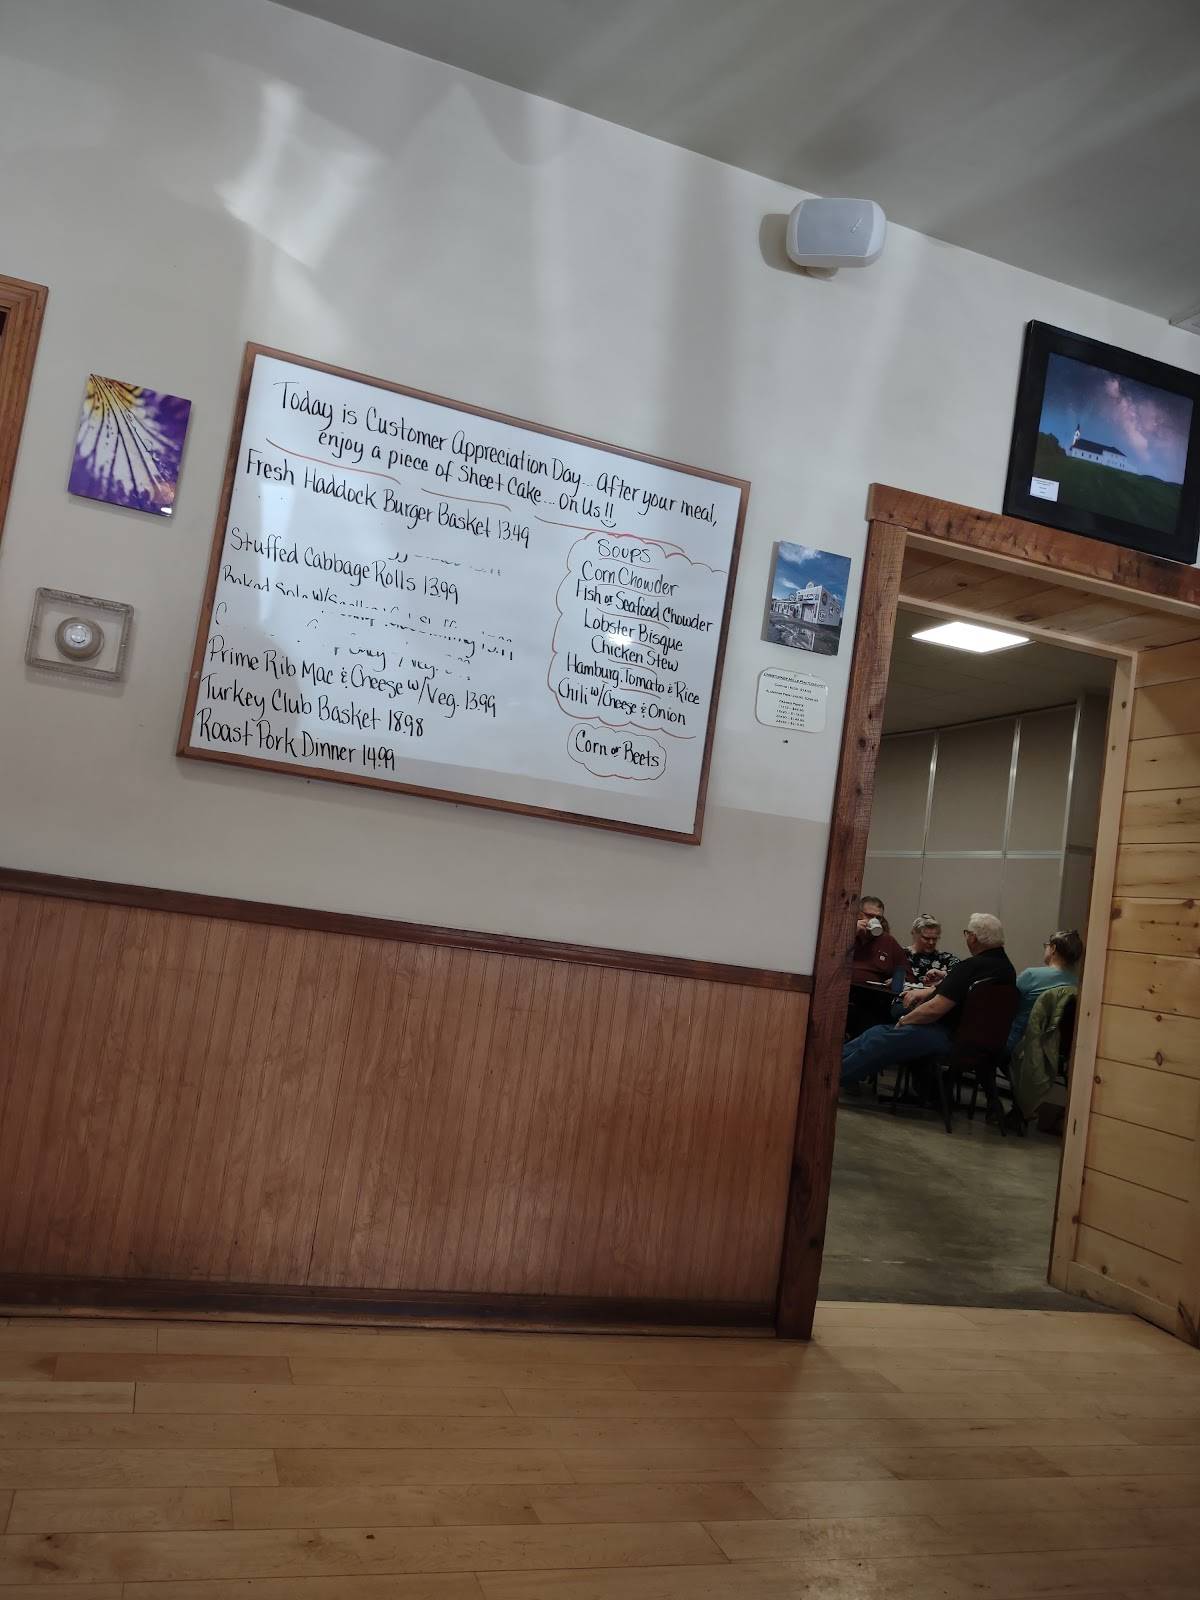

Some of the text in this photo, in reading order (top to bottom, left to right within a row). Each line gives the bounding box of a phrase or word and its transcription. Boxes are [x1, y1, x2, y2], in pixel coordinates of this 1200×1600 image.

[273, 381, 333, 432] Today
[342, 404, 358, 425] is
[366, 406, 448, 451] Customer
[451, 430, 548, 478] Appreciation
[596, 472, 642, 502] After
[638, 490, 676, 516] your
[680, 501, 719, 527] meal,
[318, 430, 365, 463] enjoy
[371, 445, 381, 460] a
[388, 448, 429, 472] piece
[435, 461, 453, 482] of
[458, 465, 504, 492] Sheet
[246, 448, 295, 485] Fresh
[304, 466, 378, 510] Haddock
[383, 489, 433, 530] Burger
[437, 502, 492, 538] Basket
[230, 527, 298, 565] Stuffed
[304, 547, 371, 587] Cabbage
[372, 560, 416, 592] Rolls
[582, 560, 680, 597] Corn Chowder
[575, 578, 714, 631] Fish or Seafood Chowder
[584, 608, 683, 656] Lobster Bisque
[208, 634, 260, 671] Prime
[264, 649, 296, 679] Rib
[301, 663, 334, 686] Mac
[351, 664, 405, 698] Cheese
[591, 635, 679, 672] Chicken Stew
[202, 673, 265, 721] Turkey
[271, 688, 313, 715] Club
[317, 694, 382, 730] Basket
[558, 677, 588, 705] Chili
[649, 704, 686, 725] Onion
[620, 667, 664, 693] Tomato
[674, 681, 700, 704] Rice
[196, 707, 254, 746] Roast
[257, 719, 298, 758] Pork
[301, 731, 357, 764] Dinner
[575, 729, 660, 767] Corn or Beets
